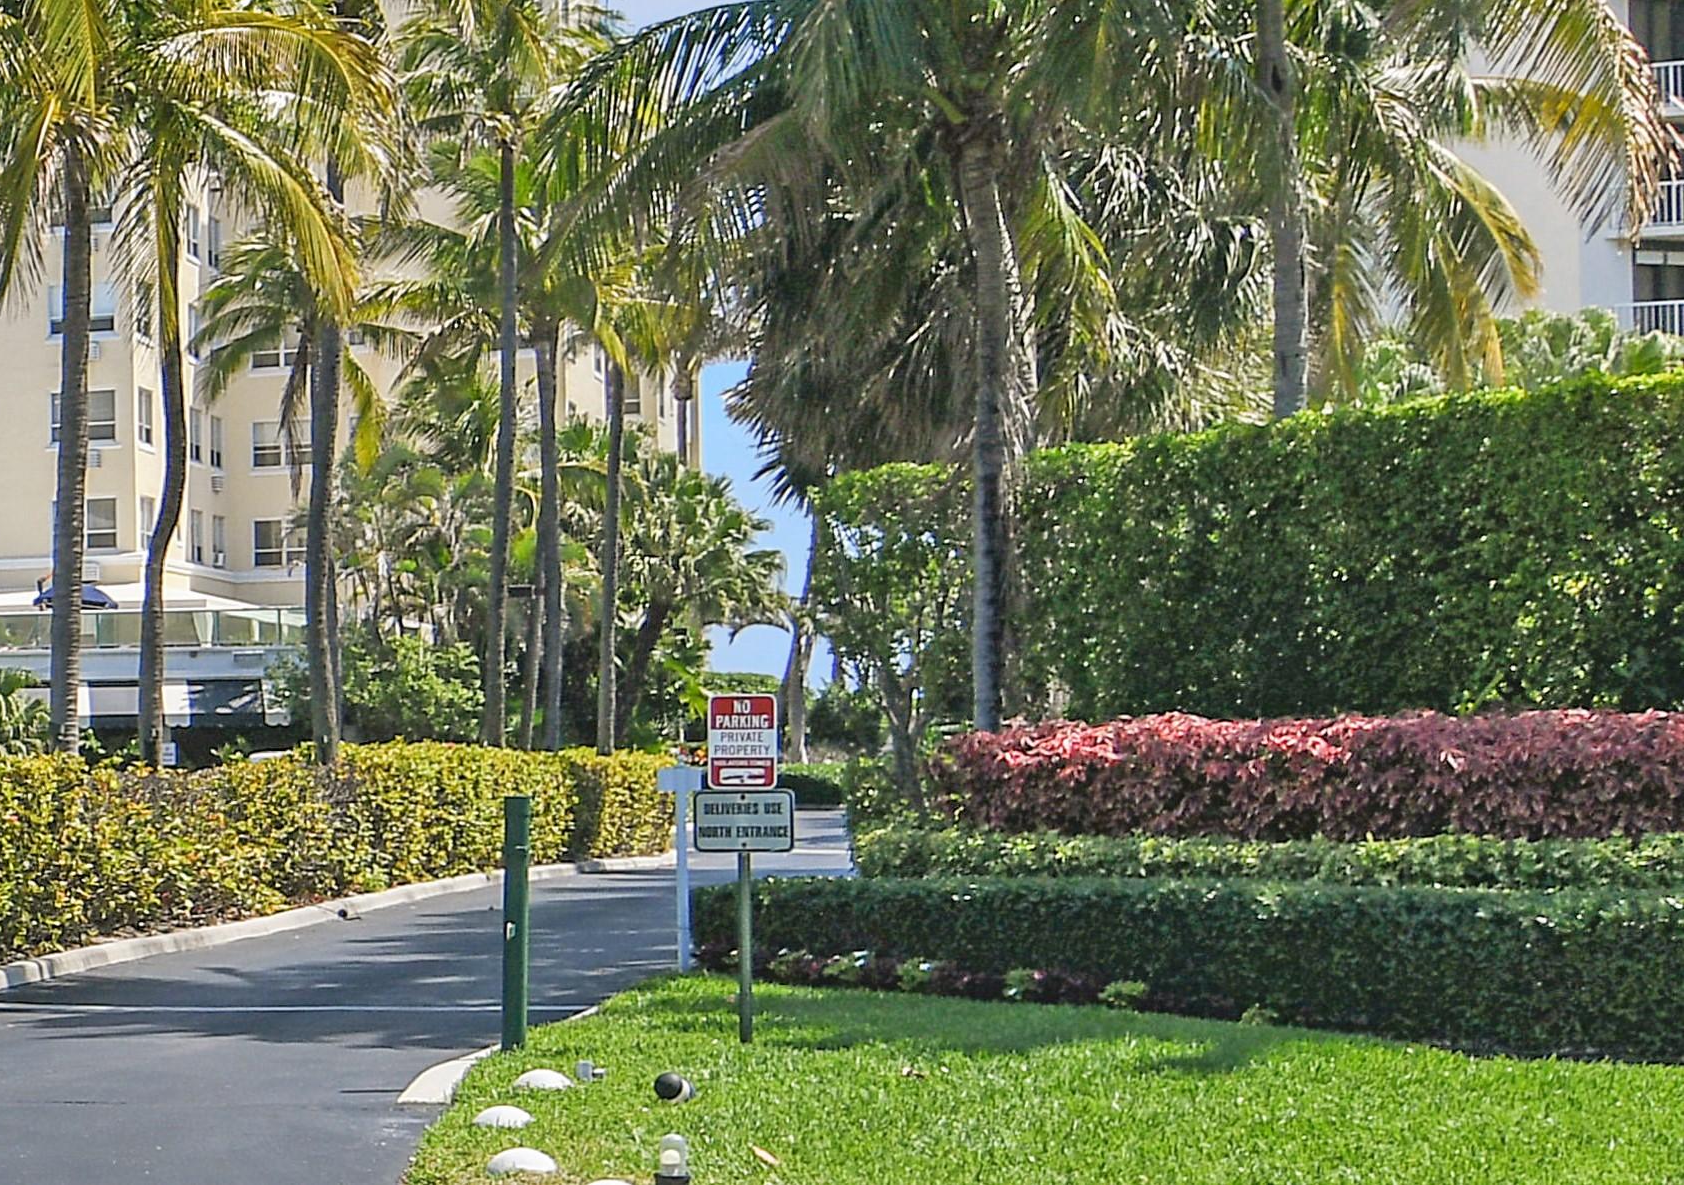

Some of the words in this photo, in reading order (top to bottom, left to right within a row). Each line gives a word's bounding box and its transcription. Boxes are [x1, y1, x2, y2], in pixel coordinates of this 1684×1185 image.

[733, 700, 751, 714] NO
[715, 715, 769, 729] PARKING
[720, 732, 764, 743] PRIVATE
[714, 744, 771, 756] PROPERTY
[703, 803, 759, 815] DELIVERIES
[763, 803, 783, 815] USE
[698, 826, 732, 839] NORTH
[736, 826, 789, 839] ENTRANCE
